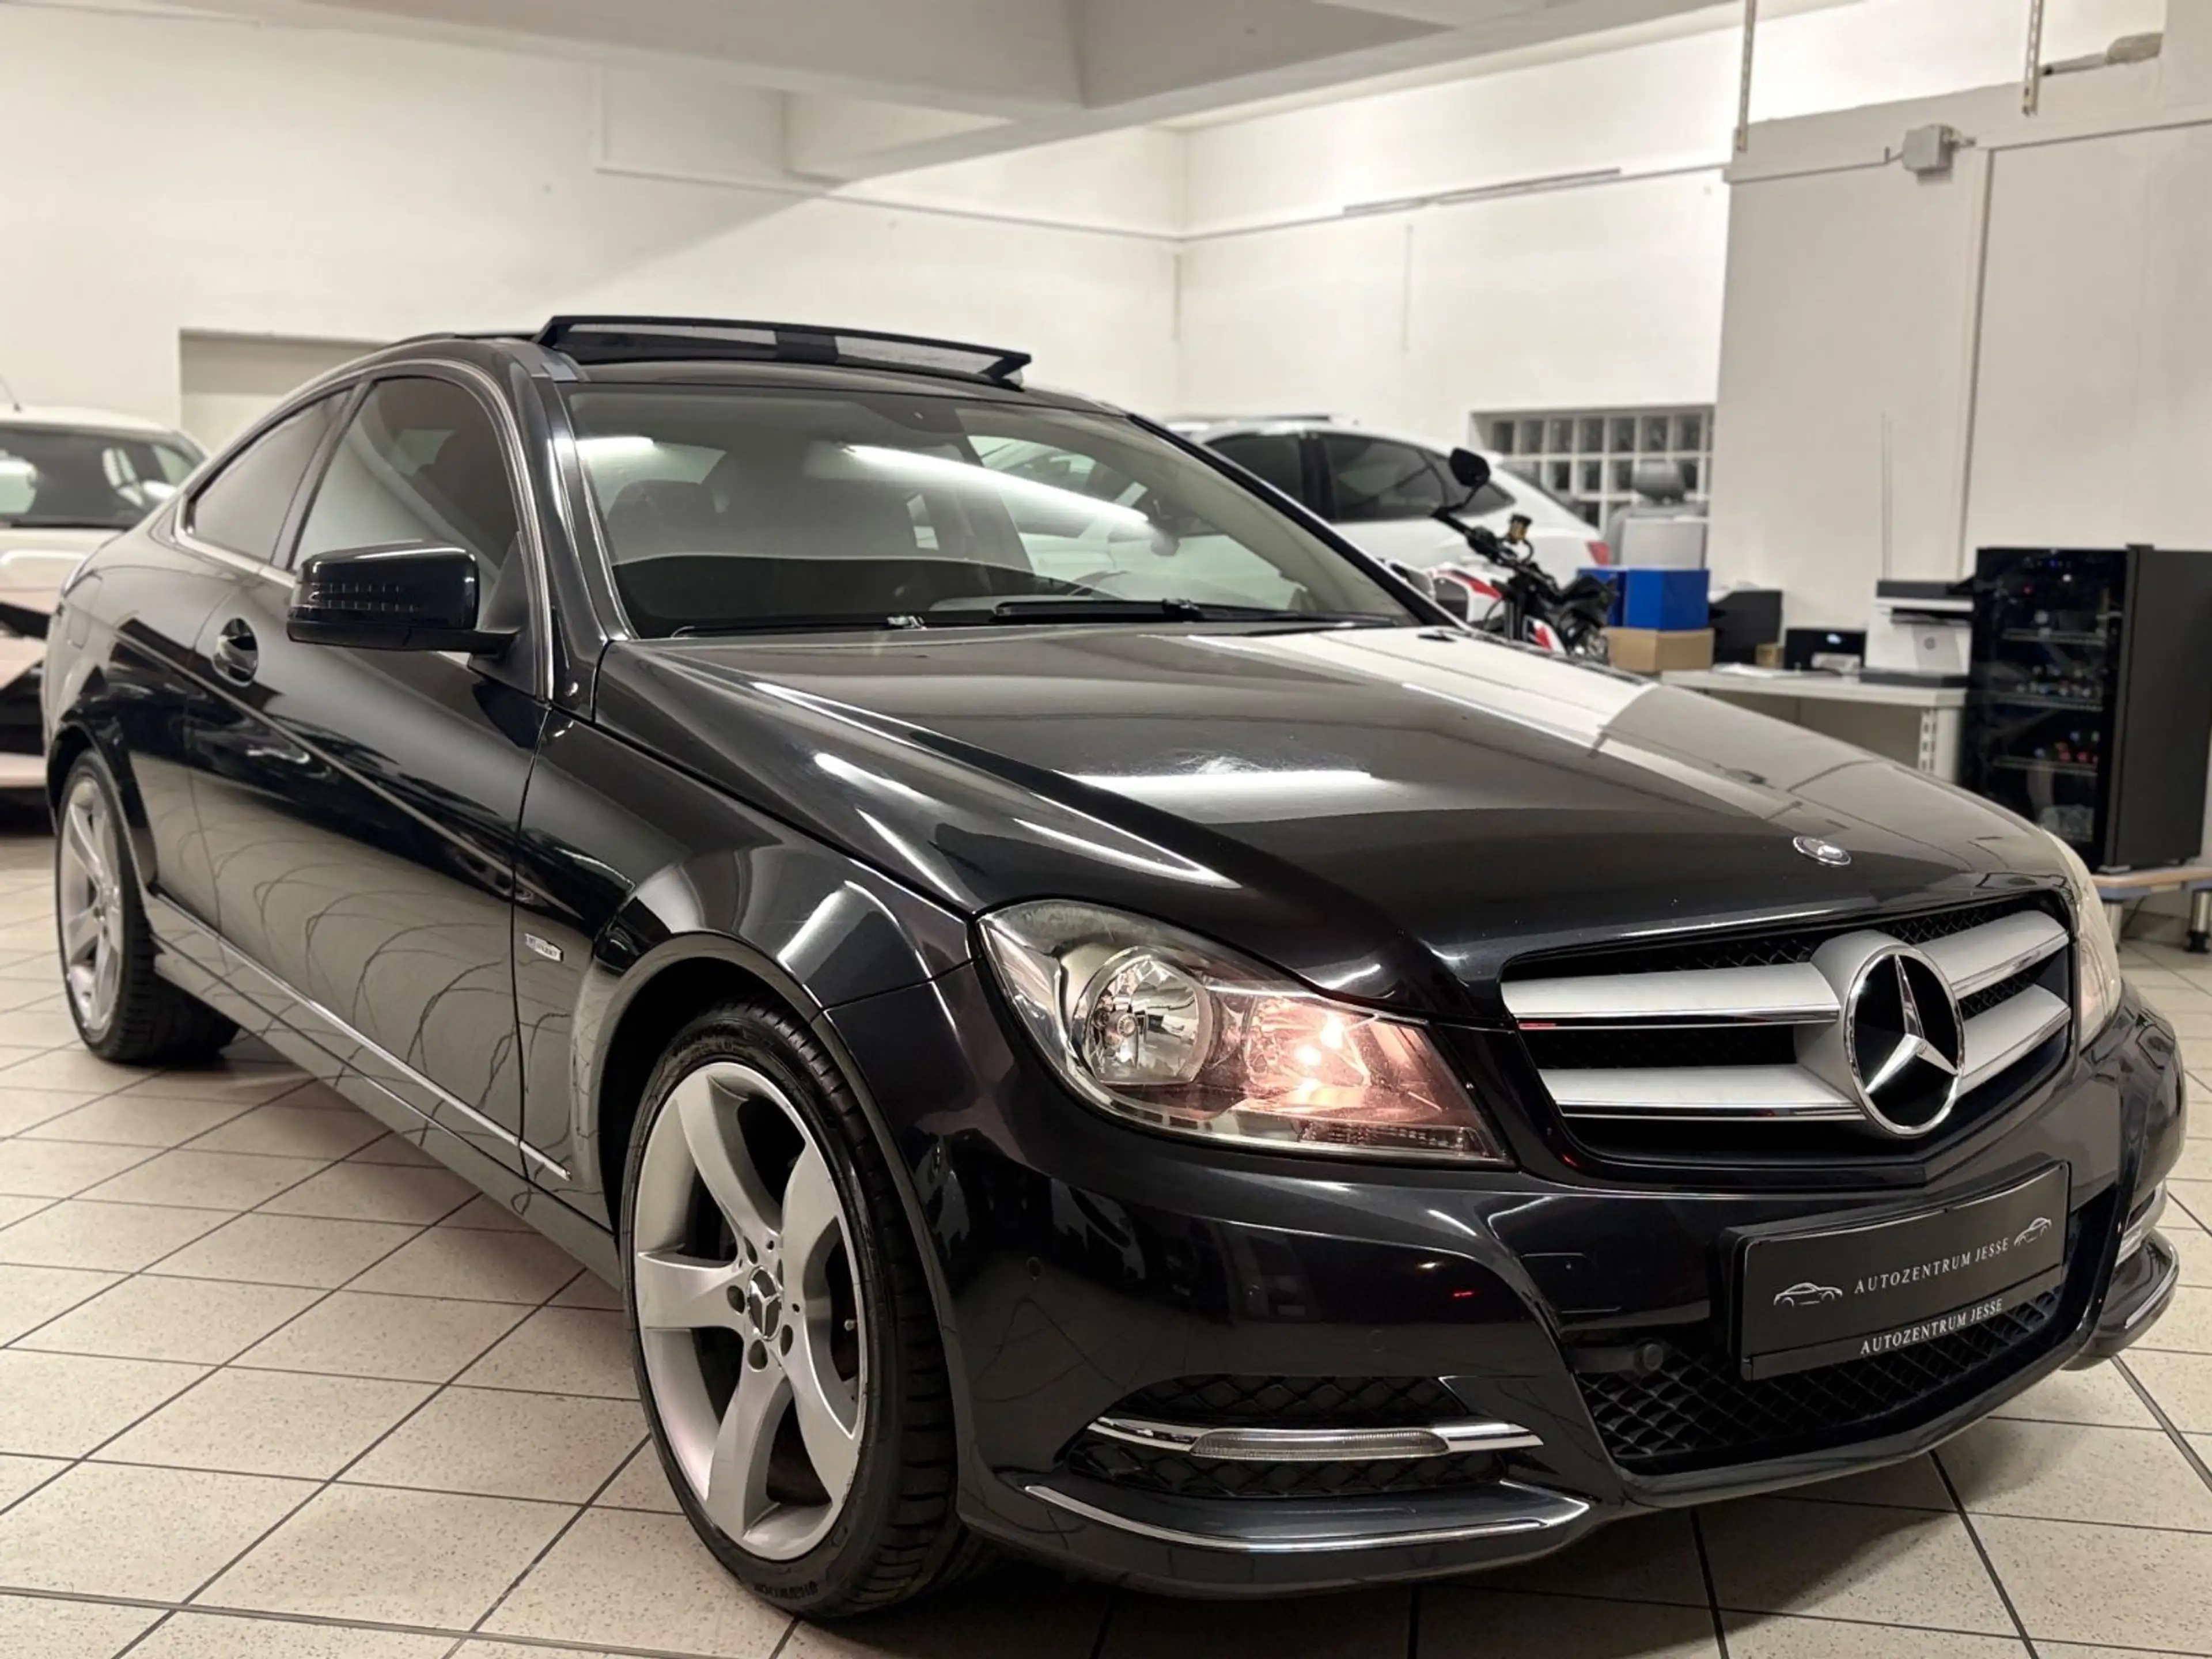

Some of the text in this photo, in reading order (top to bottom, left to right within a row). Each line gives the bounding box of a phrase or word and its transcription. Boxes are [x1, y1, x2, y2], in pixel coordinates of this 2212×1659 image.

[1854, 1237, 2009, 1294] AUTOZENTRUM JESSE
[1861, 1298, 2003, 1355] AUTOZENTRUM JESSE
